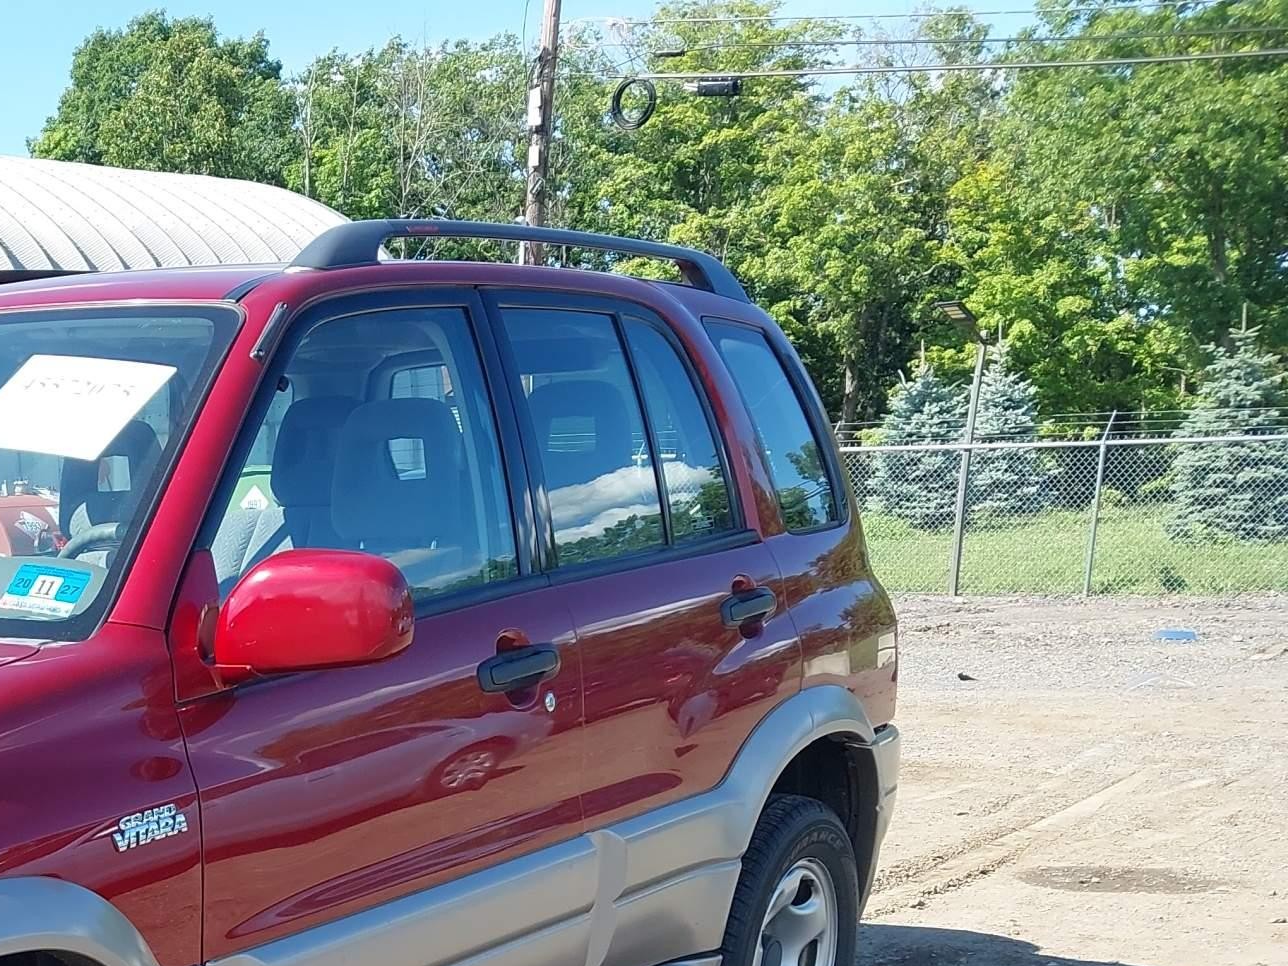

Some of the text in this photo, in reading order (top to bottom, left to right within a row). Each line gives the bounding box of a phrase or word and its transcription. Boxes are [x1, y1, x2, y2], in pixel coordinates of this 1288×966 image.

[15, 578, 81, 596] 20 11 27
[118, 803, 177, 831] GRAND
[112, 813, 188, 853] VITARA
